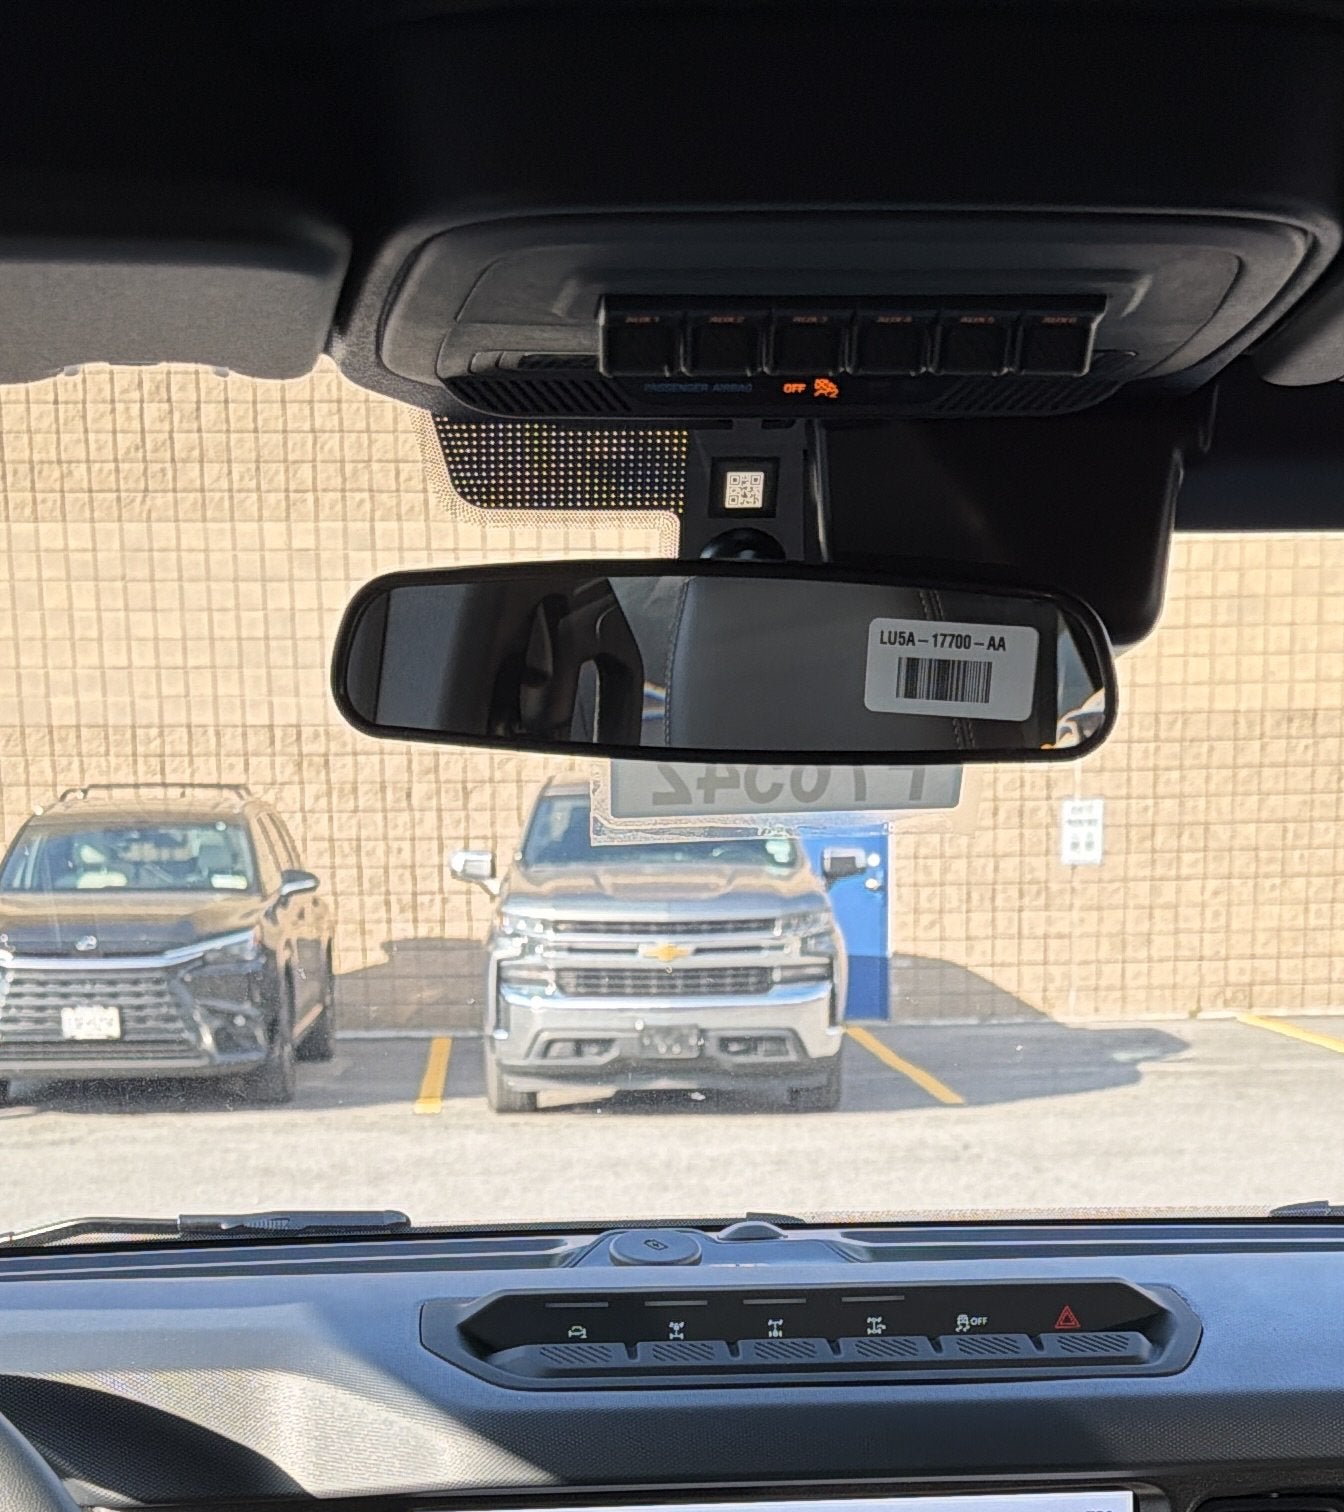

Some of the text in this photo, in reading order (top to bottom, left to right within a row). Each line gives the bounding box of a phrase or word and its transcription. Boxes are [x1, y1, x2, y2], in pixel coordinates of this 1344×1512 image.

[643, 382, 807, 394] PASSENGER AIRBAG OFF
[969, 1316, 988, 1326] OFF
